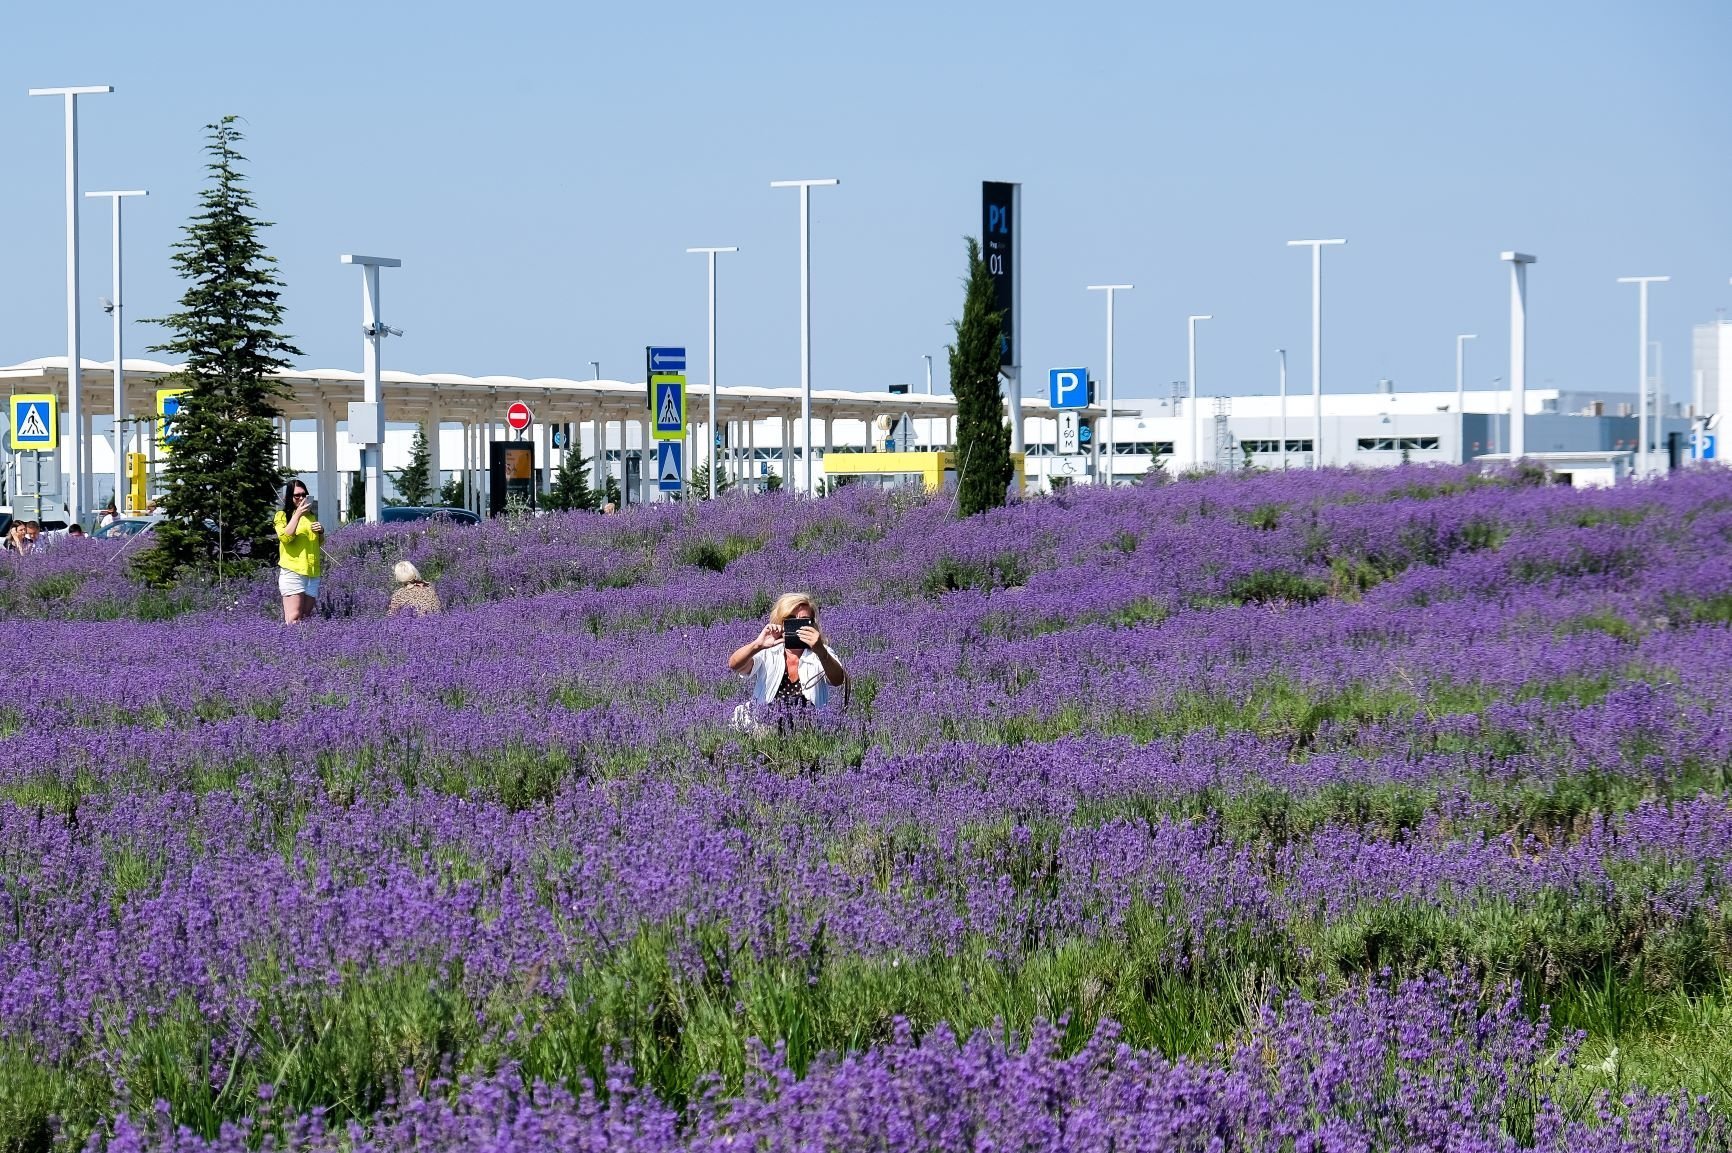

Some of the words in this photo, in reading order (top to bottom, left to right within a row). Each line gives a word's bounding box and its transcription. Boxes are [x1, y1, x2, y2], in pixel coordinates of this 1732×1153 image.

[989, 204, 1008, 234] P1
[990, 253, 1004, 275] 01
[1056, 372, 1079, 405] P
[1063, 429, 1075, 439] 60
